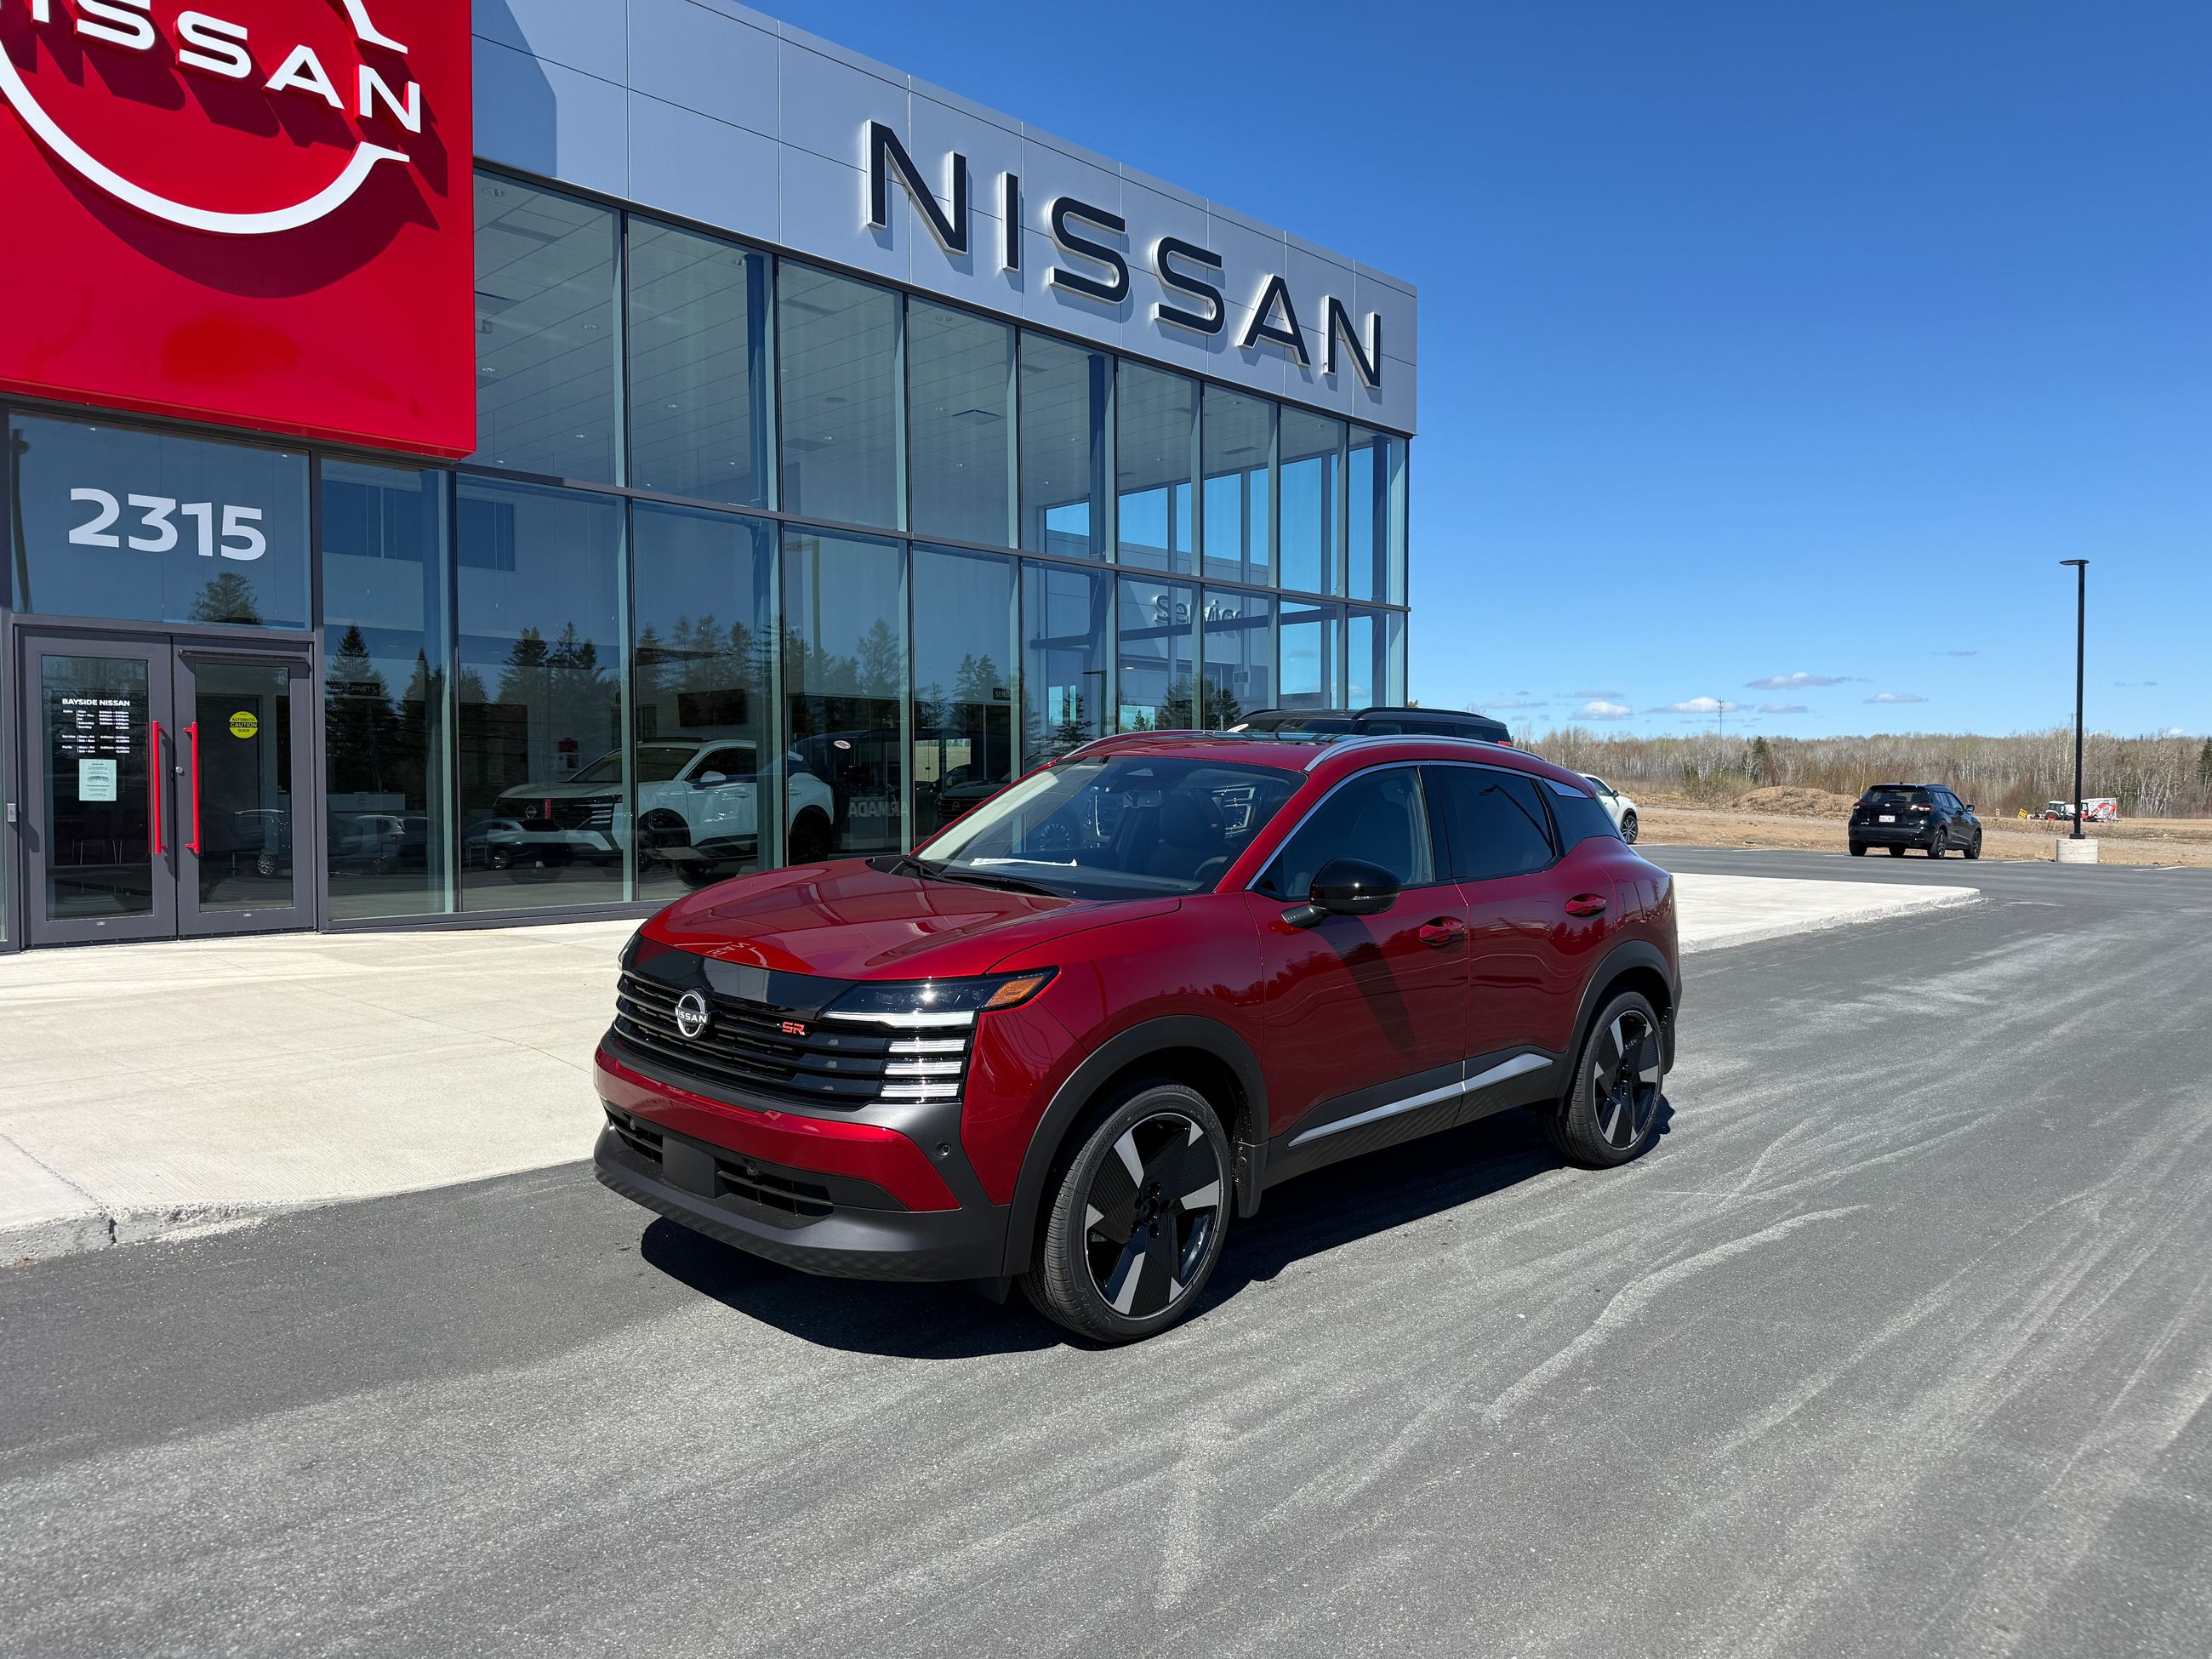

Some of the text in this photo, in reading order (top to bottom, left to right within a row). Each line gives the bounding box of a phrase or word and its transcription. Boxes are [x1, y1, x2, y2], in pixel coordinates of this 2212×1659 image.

[0, 0, 421, 134] SSAN
[864, 118, 1382, 390] NISSAN
[68, 487, 266, 562] 2315
[676, 1007, 707, 1023] NISSAN
[782, 1022, 806, 1035] SR
